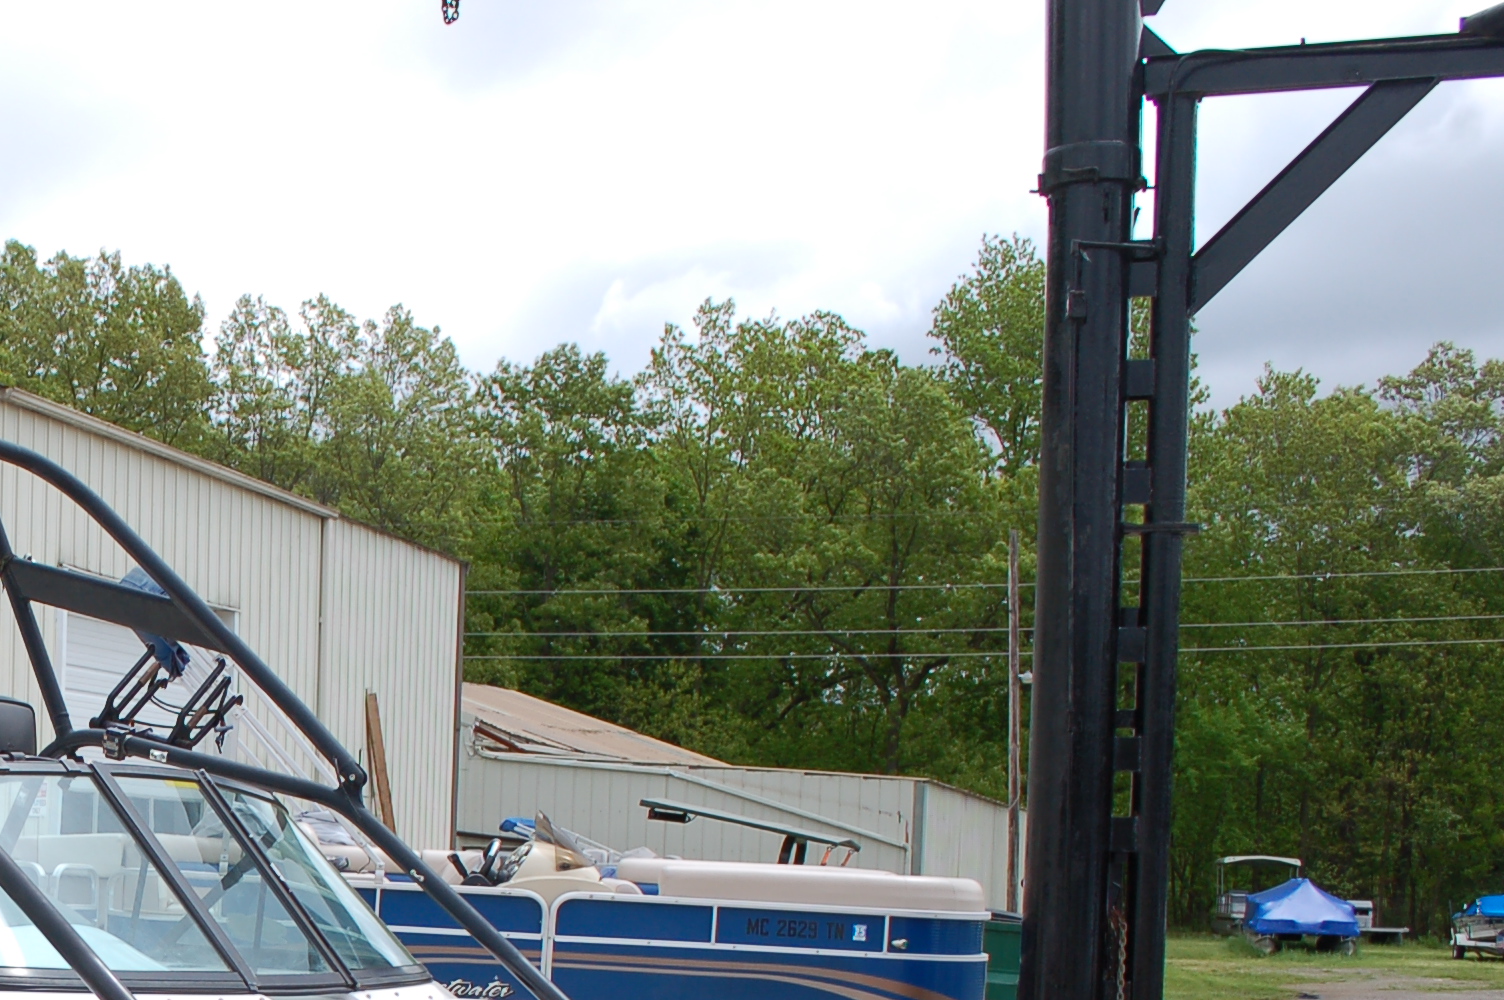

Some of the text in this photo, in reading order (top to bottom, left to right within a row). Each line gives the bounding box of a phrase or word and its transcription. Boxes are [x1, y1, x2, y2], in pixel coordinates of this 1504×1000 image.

[747, 918, 844, 939] MC 2629 TN
